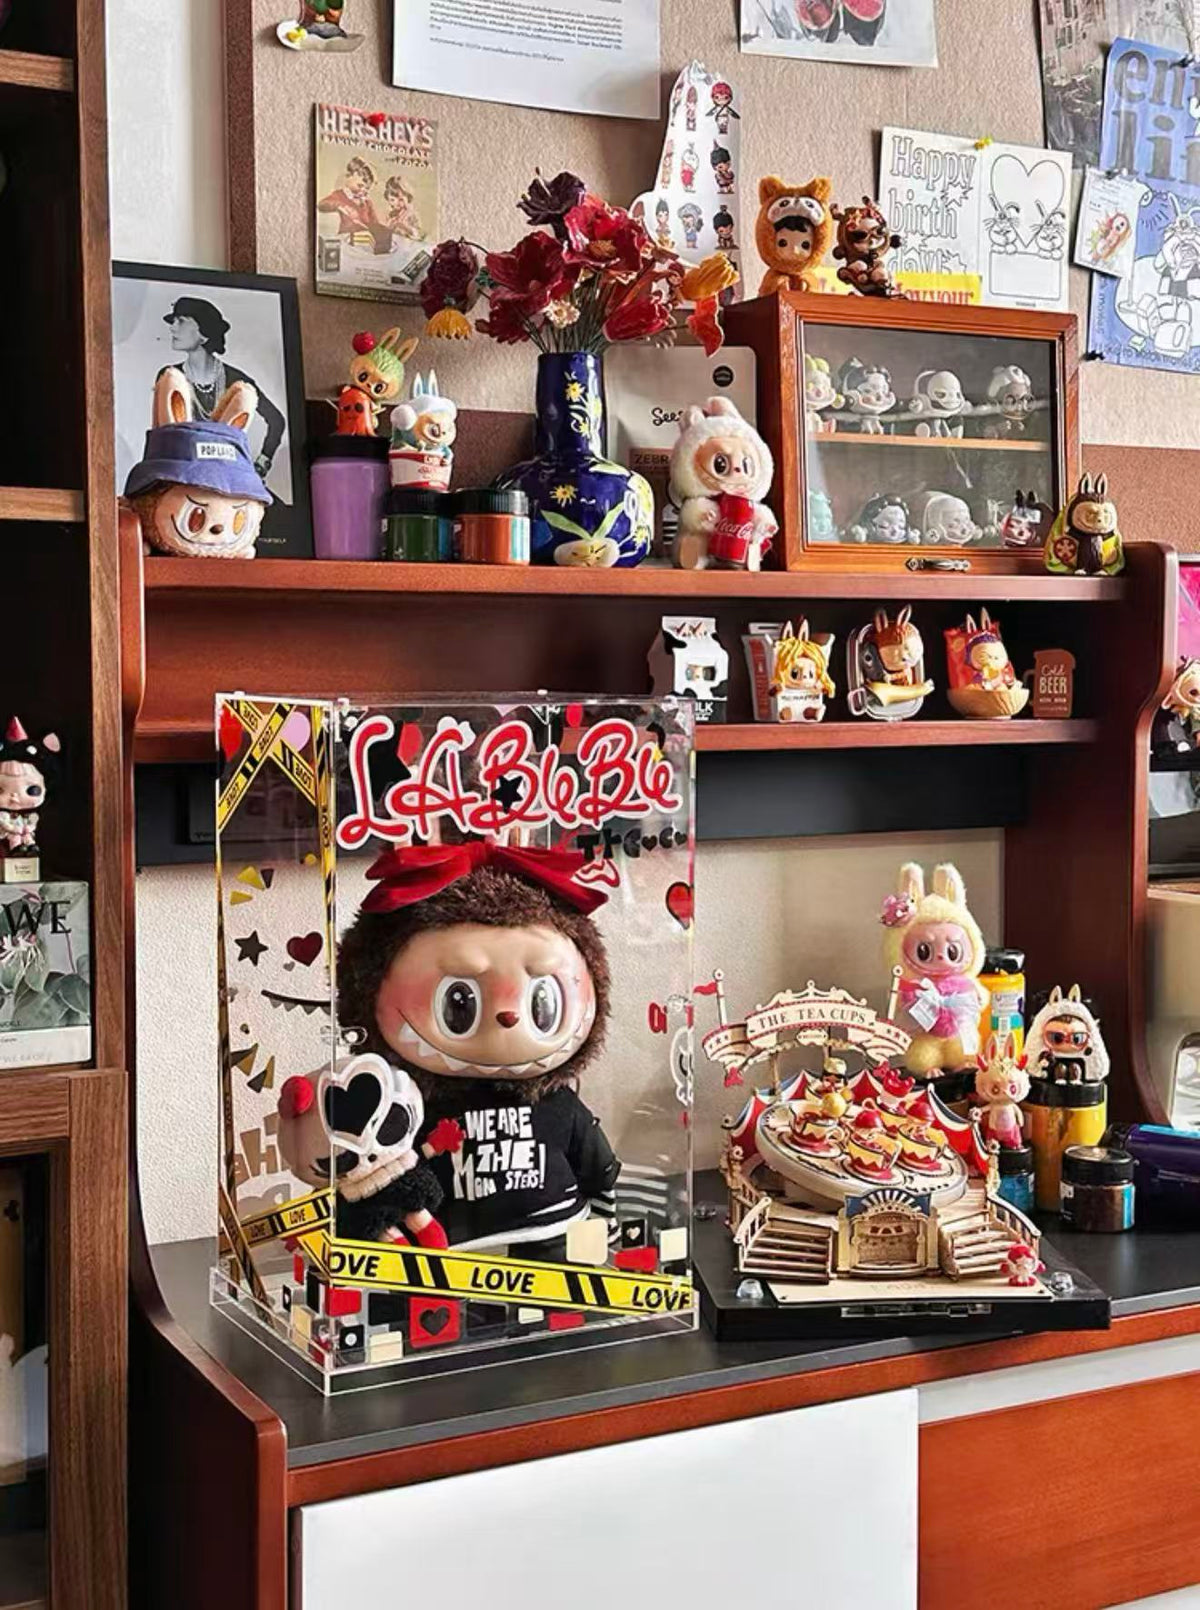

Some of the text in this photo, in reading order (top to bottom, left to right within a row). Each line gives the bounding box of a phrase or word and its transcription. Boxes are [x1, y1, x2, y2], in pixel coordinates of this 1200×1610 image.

[890, 135, 977, 191] Happy
[888, 188, 959, 239] birth
[634, 453, 670, 465] ZEBR
[1040, 676, 1067, 694] BEER
[694, 701, 713, 713] ILK
[760, 1008, 866, 1029] THE TEA CUPS
[465, 1106, 534, 1142] WE ARE
[476, 1139, 536, 1172] THE
[471, 1267, 536, 1295] LOVE
